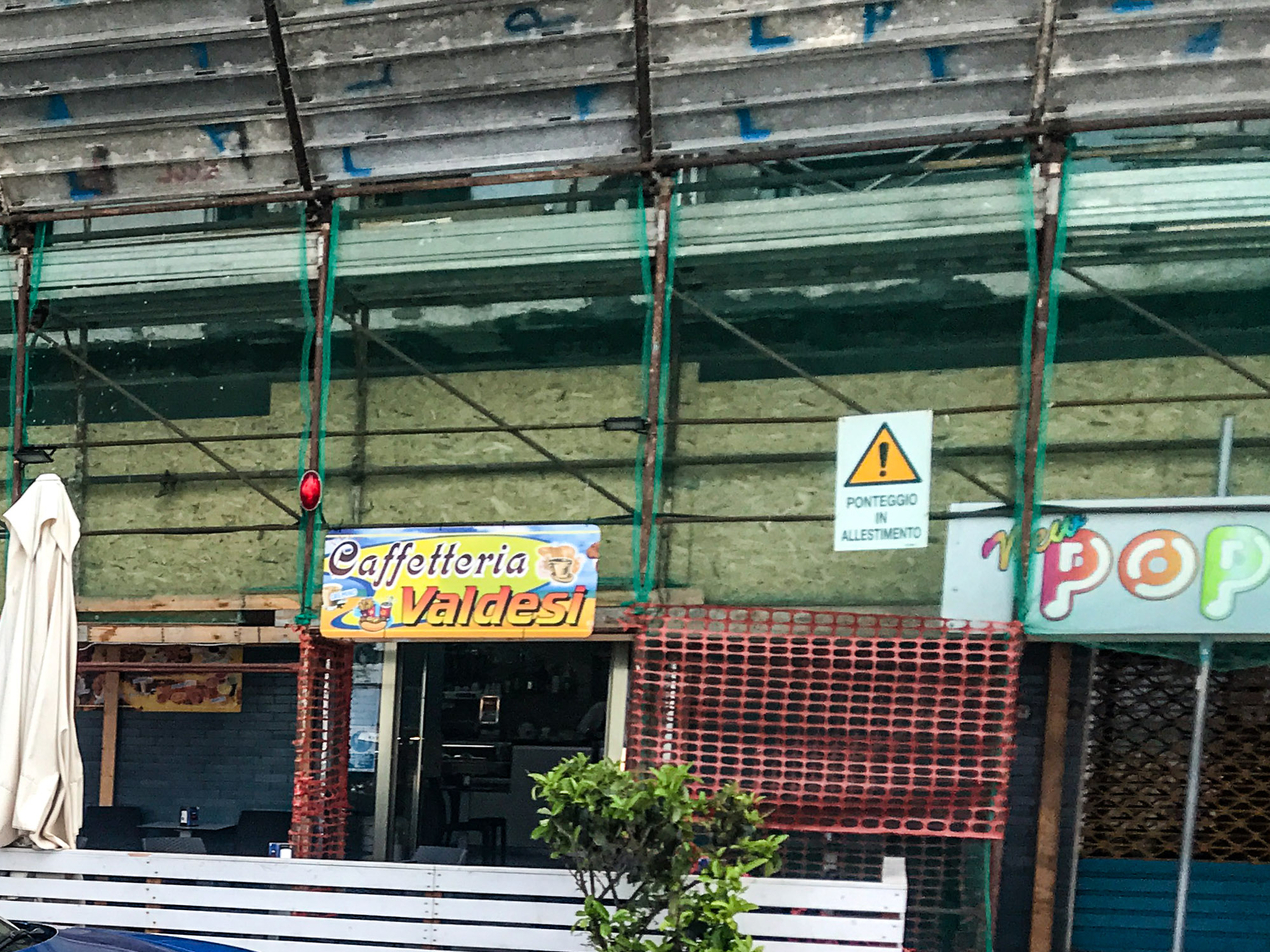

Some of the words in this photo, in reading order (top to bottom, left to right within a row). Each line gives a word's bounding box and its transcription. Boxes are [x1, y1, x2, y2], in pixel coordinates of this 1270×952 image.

[846, 493, 918, 509] PONTEGGIO
[874, 511, 888, 524] IN
[841, 526, 922, 542] ALLESTIMENTO
[328, 540, 529, 587] Caffetteria
[401, 584, 589, 628] Valdesi
